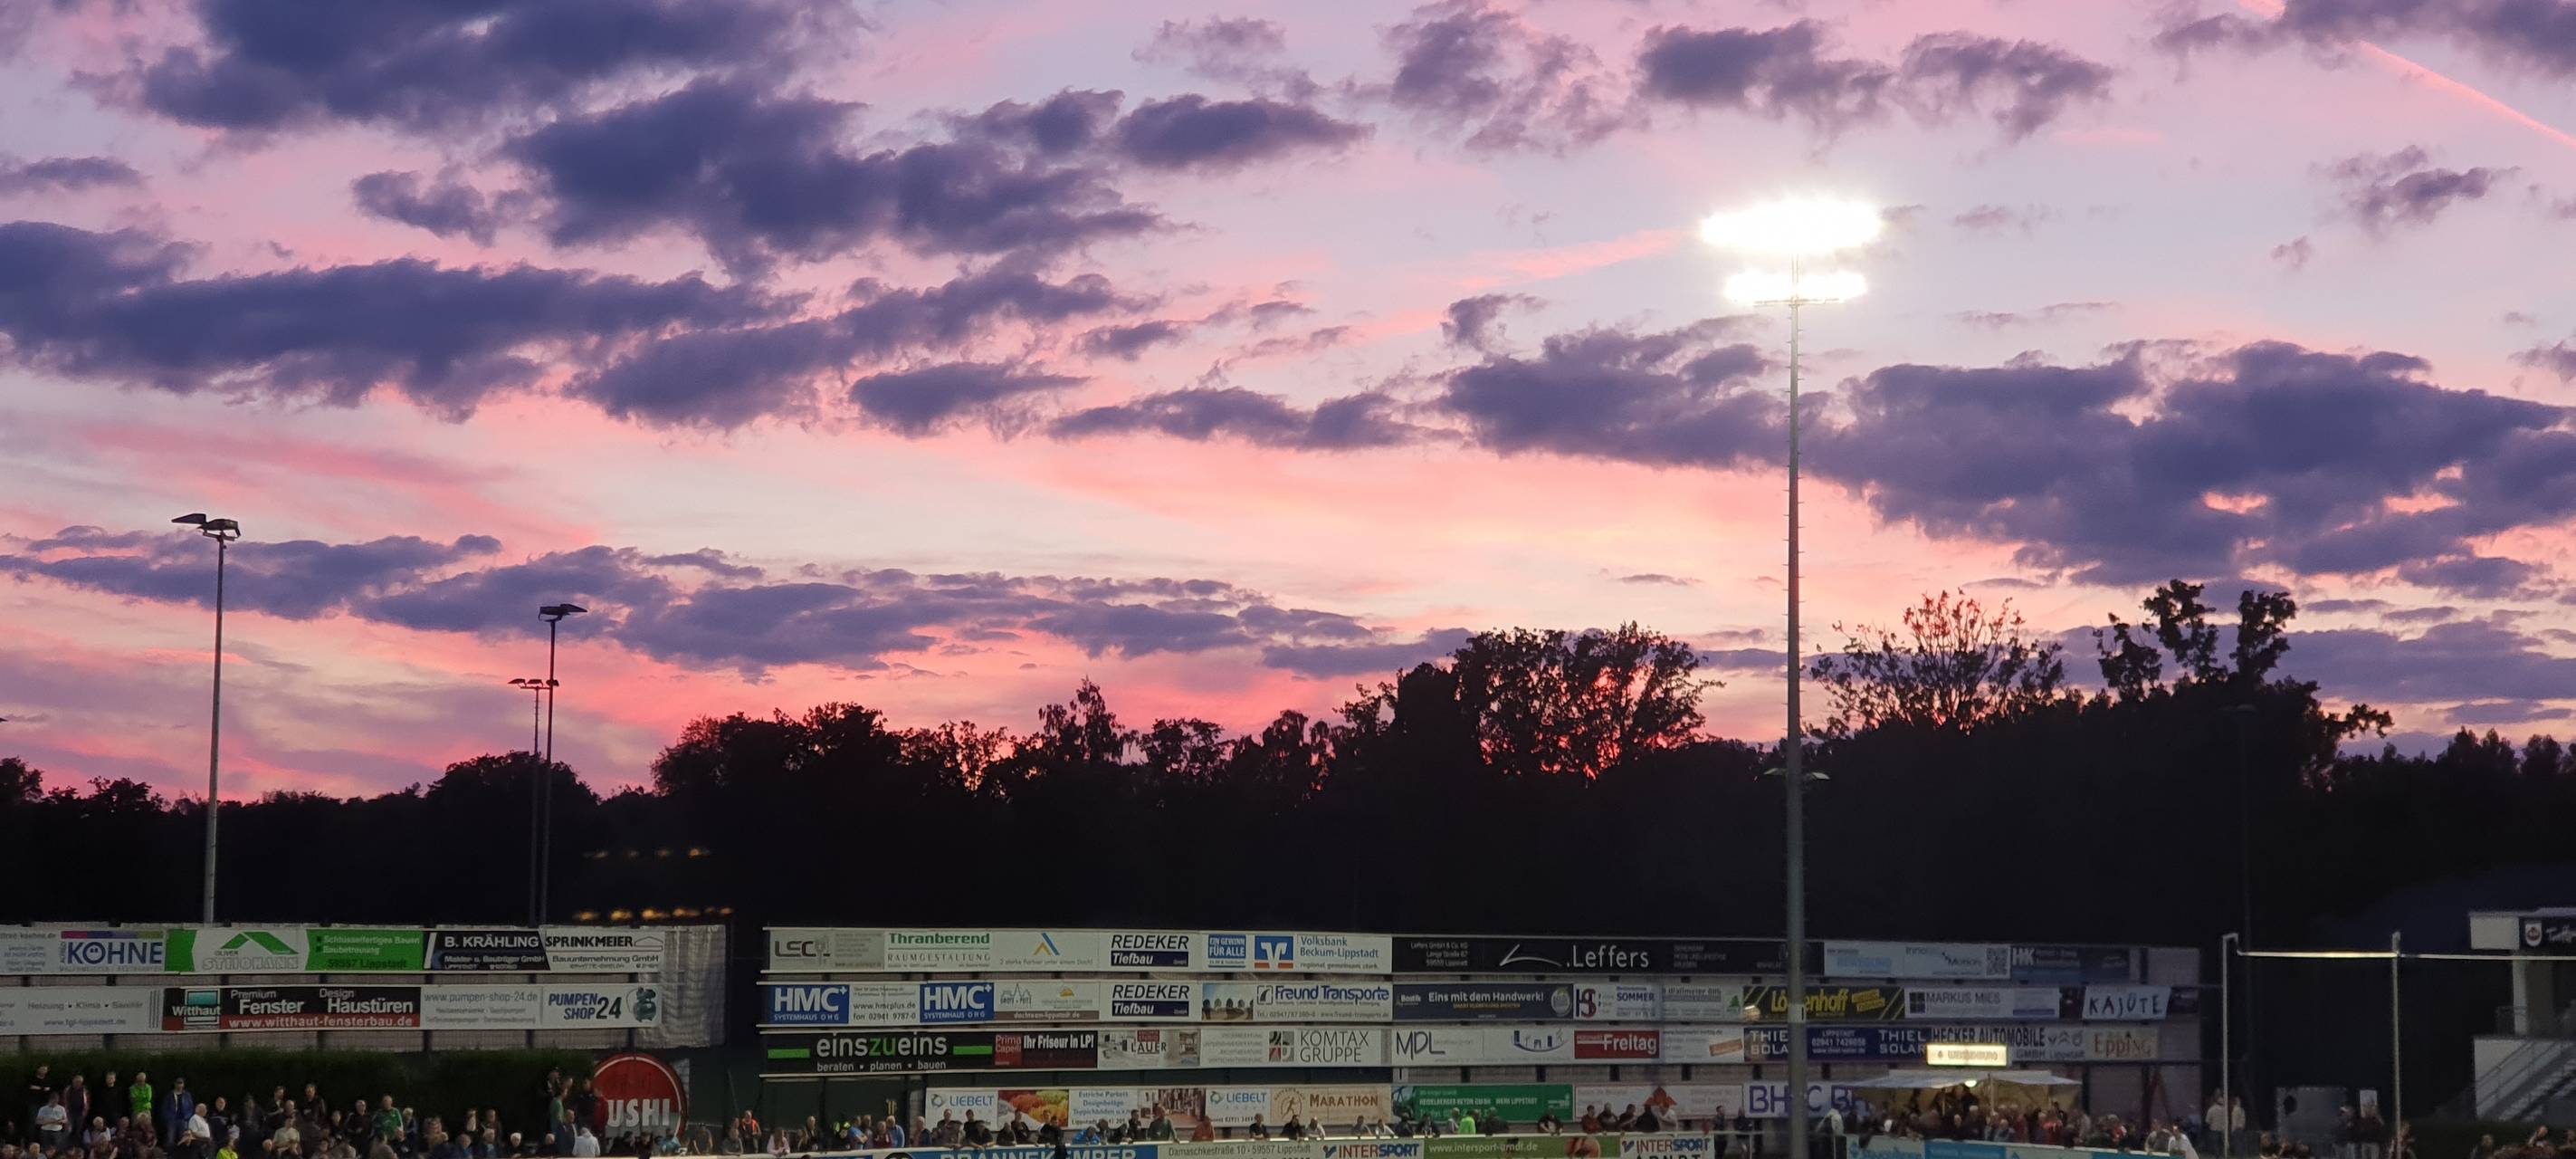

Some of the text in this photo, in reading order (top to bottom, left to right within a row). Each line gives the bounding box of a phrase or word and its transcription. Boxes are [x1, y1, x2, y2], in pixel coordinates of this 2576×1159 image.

[444, 934, 539, 948] B. KRÄHLING
[546, 936, 634, 948] SPRINKMEIER
[889, 933, 990, 945] Thranberend
[1111, 934, 1189, 951] REDEKER
[1301, 935, 1347, 946] Volksbank
[1225, 946, 1245, 956] ALLE
[1300, 946, 1379, 960] Beckum-Lippstadt
[1112, 953, 1154, 965] Tiefbau
[231, 988, 354, 1000] Premium Design
[424, 991, 539, 1003] www.pumpen-shop-24.de
[1112, 984, 1189, 1000] REDEKER
[1275, 985, 1390, 1006] Freund Transporte
[1428, 991, 1544, 1002] Eins mit dem Handwerk!
[1617, 992, 1655, 1001] SOMMER
[172, 1005, 222, 1017] Witthaut
[239, 998, 414, 1015] Fenster Haustüren
[549, 992, 622, 1020] PUMPEN 24
[1113, 1002, 1155, 1015] Tiefbau
[564, 1008, 596, 1020] SHOP
[775, 1013, 817, 1021] SYSTEMHAUS
[228, 1015, 414, 1029] www.witthaut-fensterbau.de
[1024, 1034, 1035, 1049] Ihr
[1038, 1034, 1067, 1049] Friseur
[1070, 1034, 1078, 1049] in
[1300, 1030, 1369, 1047] KOMTAX
[1878, 1029, 1927, 1041] THIEL
[816, 1032, 948, 1058] einszueins
[1131, 1041, 1167, 1054] LAUER
[1603, 1034, 1657, 1055] Freitag
[1300, 1046, 1362, 1063] GRUPPE
[816, 1059, 947, 1072] beraten planen bauen
[950, 1094, 995, 1107] LIEBELT
[1226, 1091, 1267, 1103] LIEBELT
[607, 1097, 671, 1128] USHI
[1168, 1145, 1234, 1157] Damaschkestraße
[1236, 1144, 1246, 1154] 10
[1277, 1143, 1312, 1154] Lippstadt
[1338, 1142, 1419, 1159] INTERSPORT
[1428, 1141, 1538, 1154] www.intersport-arndt.de
[1636, 1137, 1710, 1154] INTERSPORT
